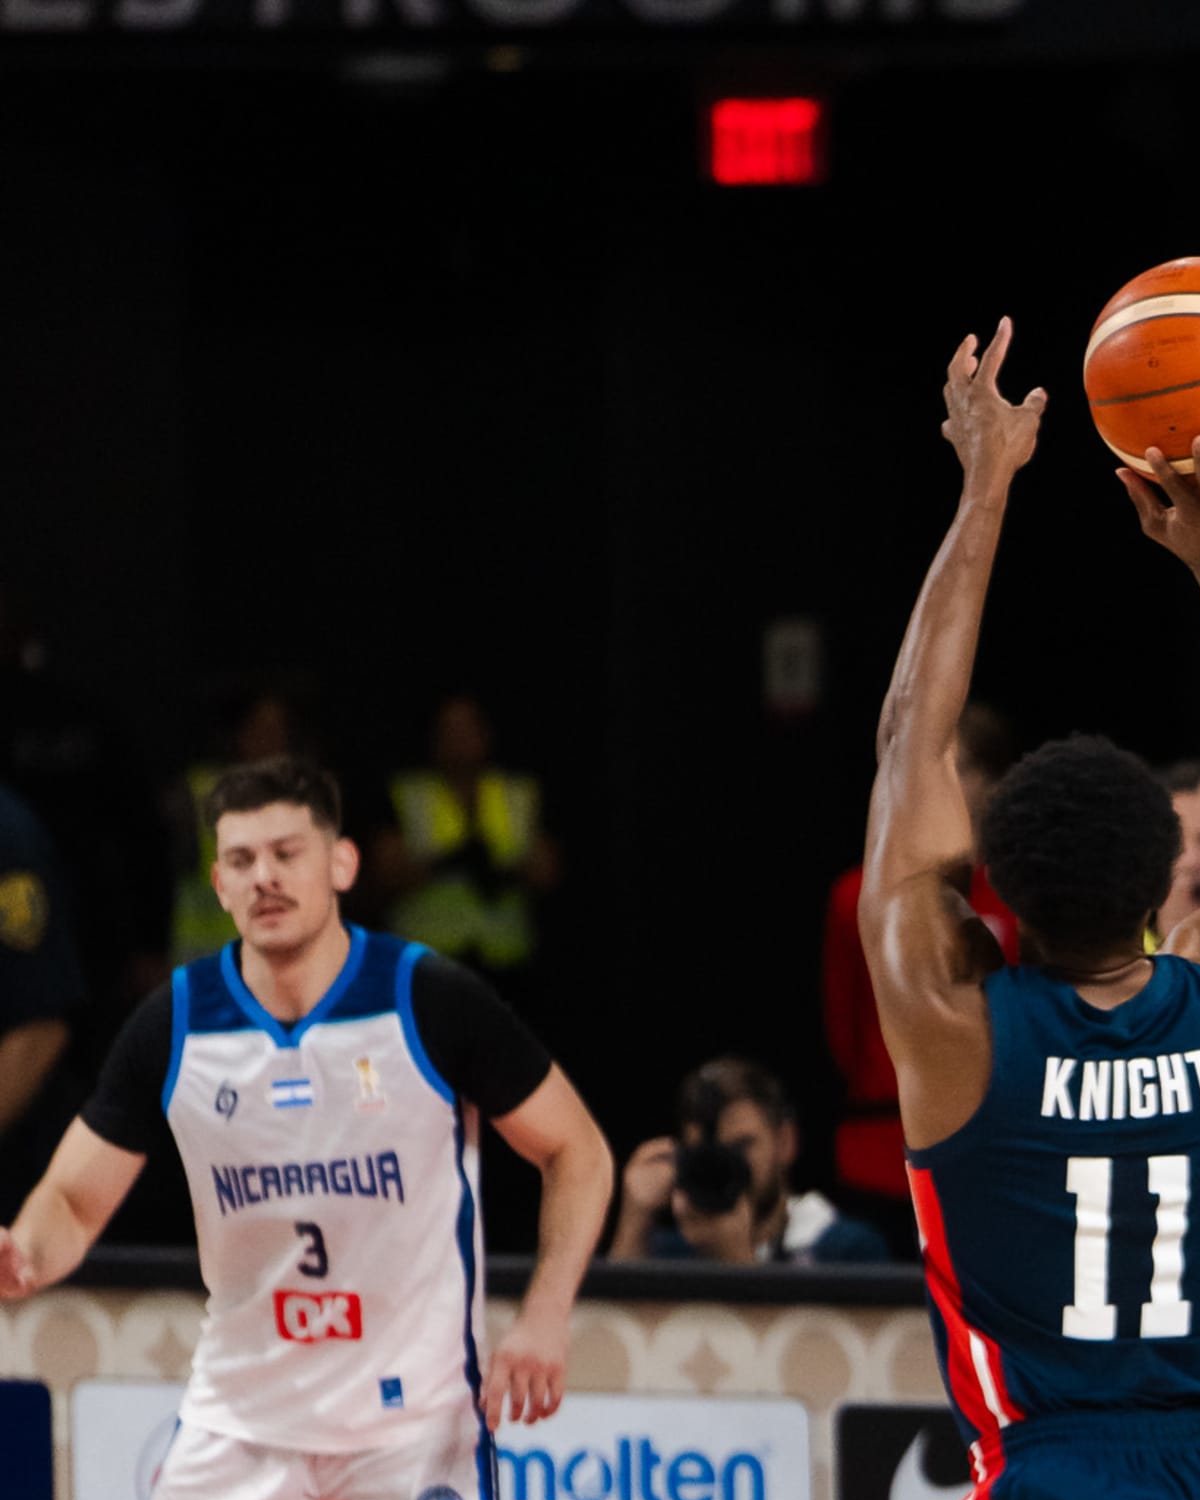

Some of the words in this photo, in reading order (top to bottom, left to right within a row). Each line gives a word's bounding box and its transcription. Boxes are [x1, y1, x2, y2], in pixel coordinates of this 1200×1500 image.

[211, 1150, 406, 1216] NICARAGUA
[295, 1222, 329, 1279] 3
[1062, 1155, 1192, 1341] 11
